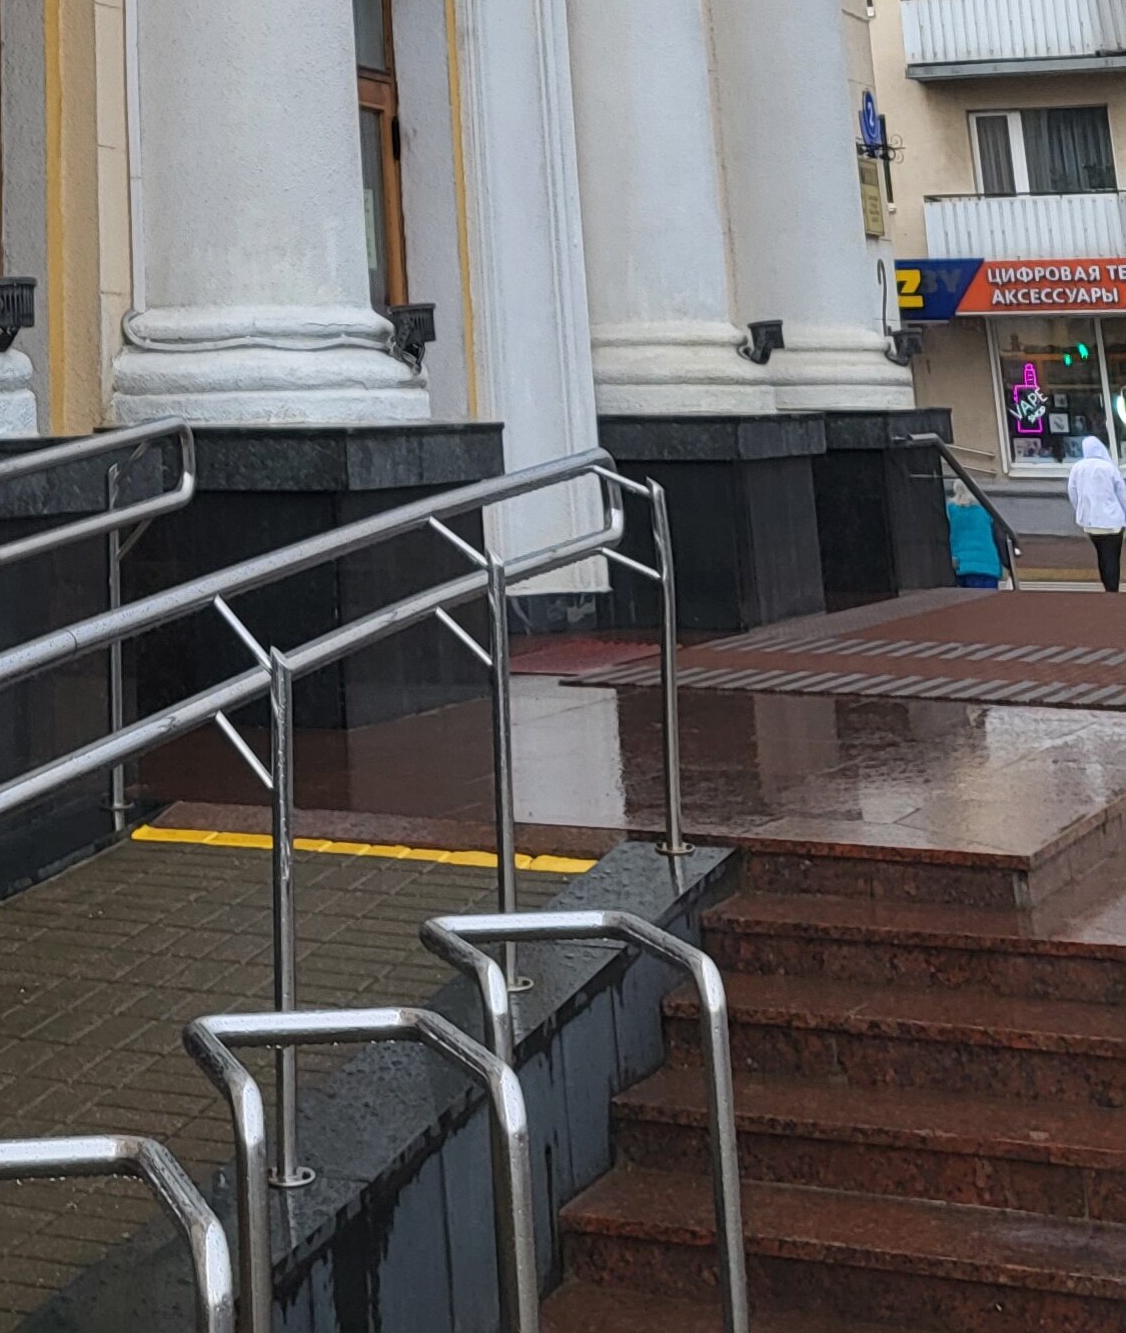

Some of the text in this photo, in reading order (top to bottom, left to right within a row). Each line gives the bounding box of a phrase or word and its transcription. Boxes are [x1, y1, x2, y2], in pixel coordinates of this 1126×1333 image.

[987, 265, 1101, 285] ЦИФРОВАЯ
[992, 287, 1119, 305] АКСЕССУАРЫ
[1009, 386, 1049, 420] VAPE
